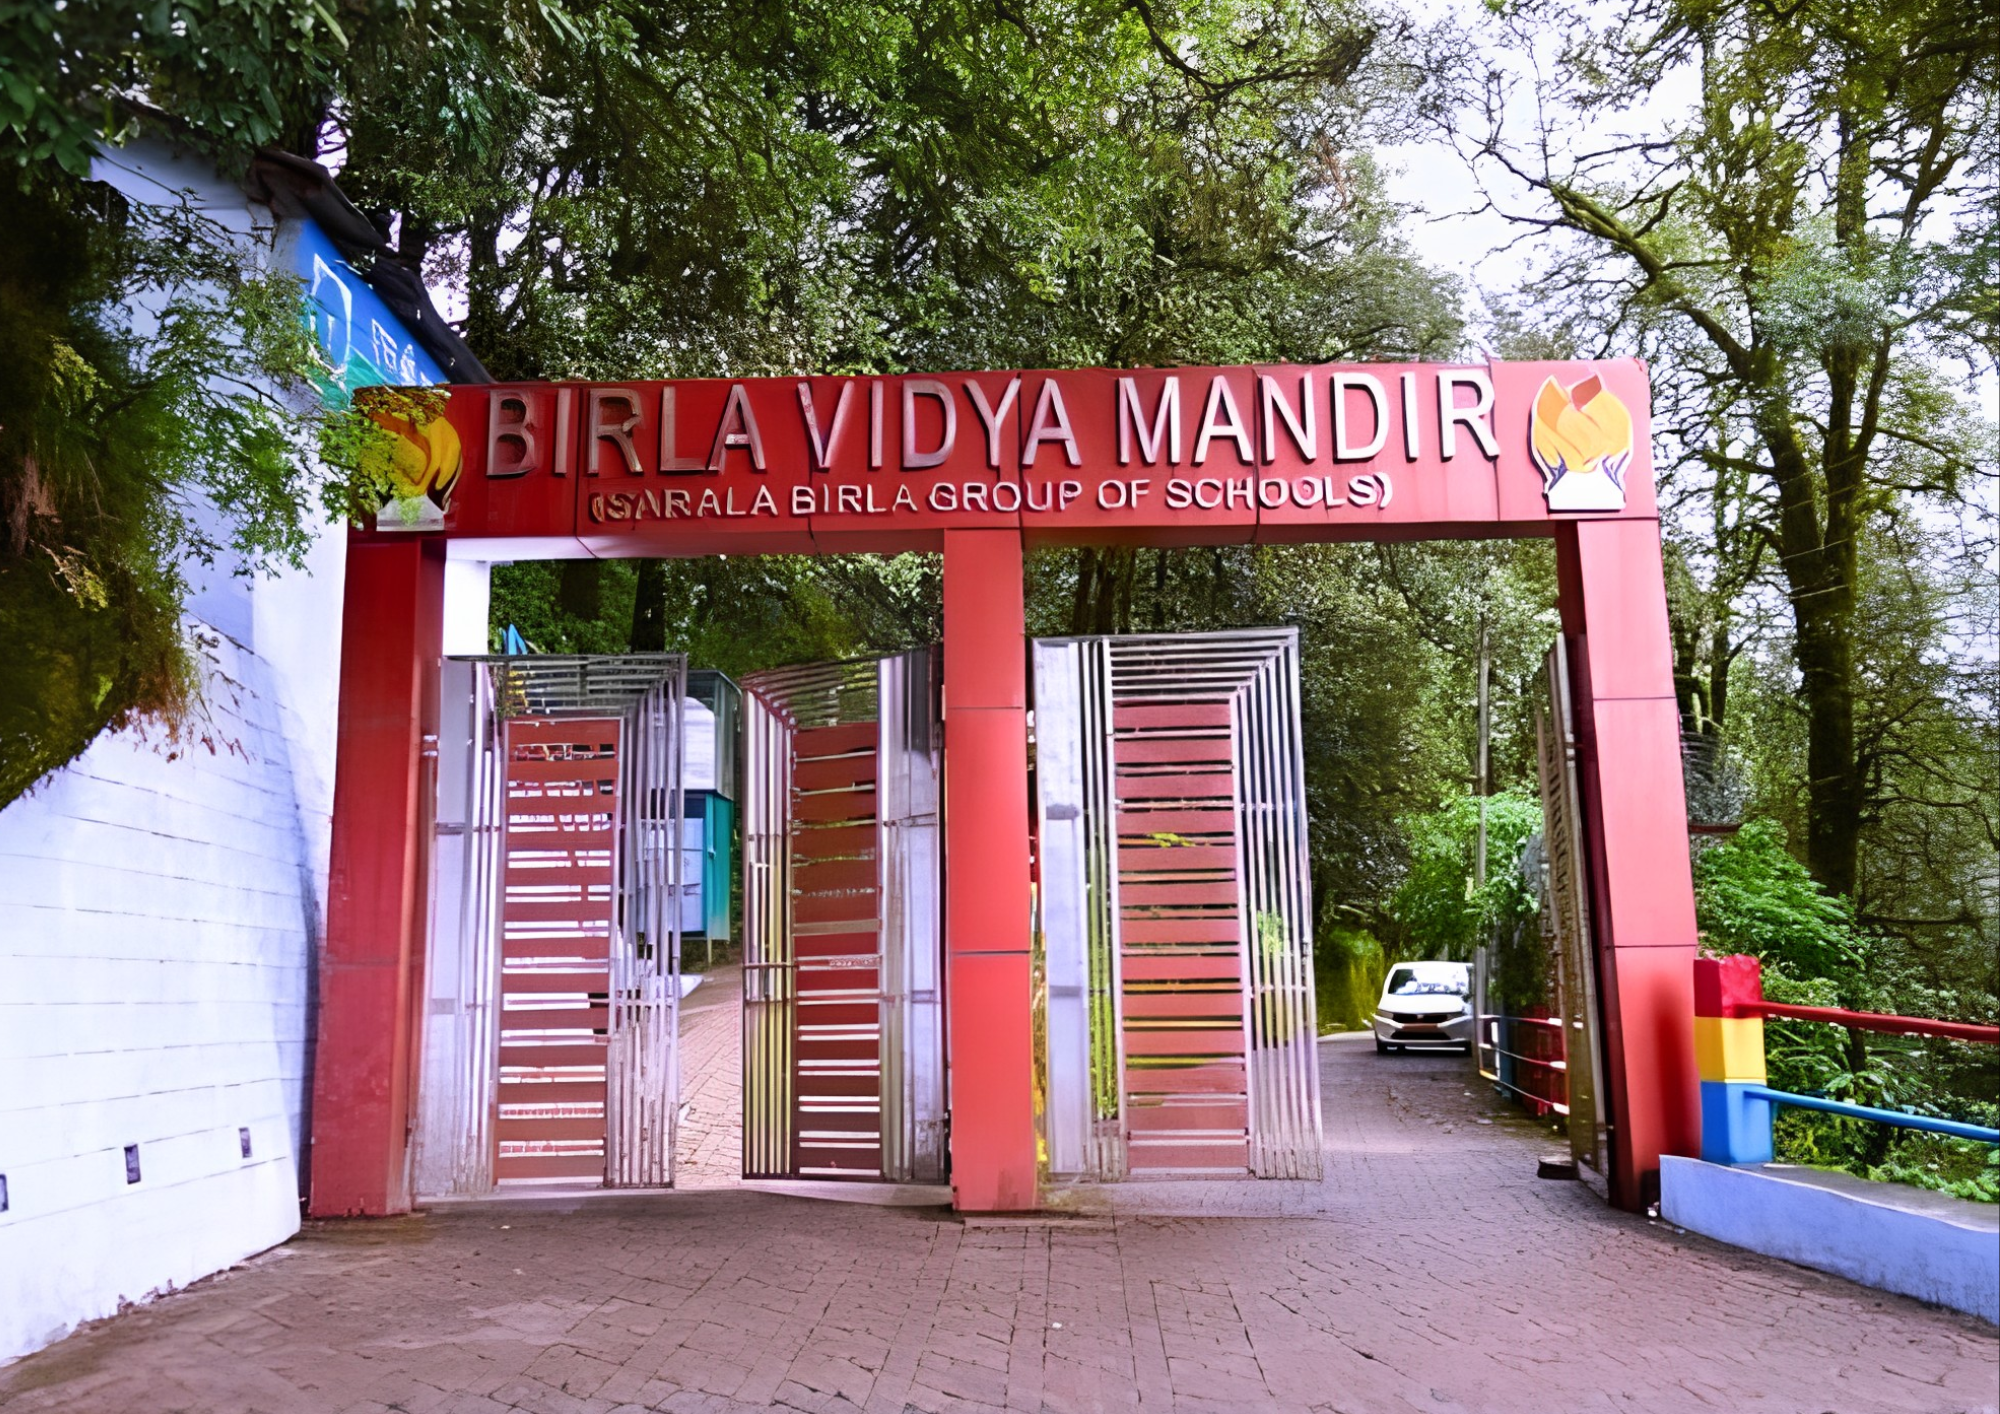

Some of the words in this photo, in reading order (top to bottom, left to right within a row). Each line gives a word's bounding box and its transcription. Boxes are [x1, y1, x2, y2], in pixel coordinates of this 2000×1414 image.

[487, 384, 766, 476] BIRLA
[798, 378, 1081, 469] VIDYA
[1118, 371, 1500, 464] MANDIR
[591, 484, 778, 523] (SARALA
[792, 484, 918, 514] BIRLA
[929, 482, 1082, 511] GROUP
[1098, 479, 1150, 509] OF
[1166, 473, 1394, 510] SCHOOLS)
